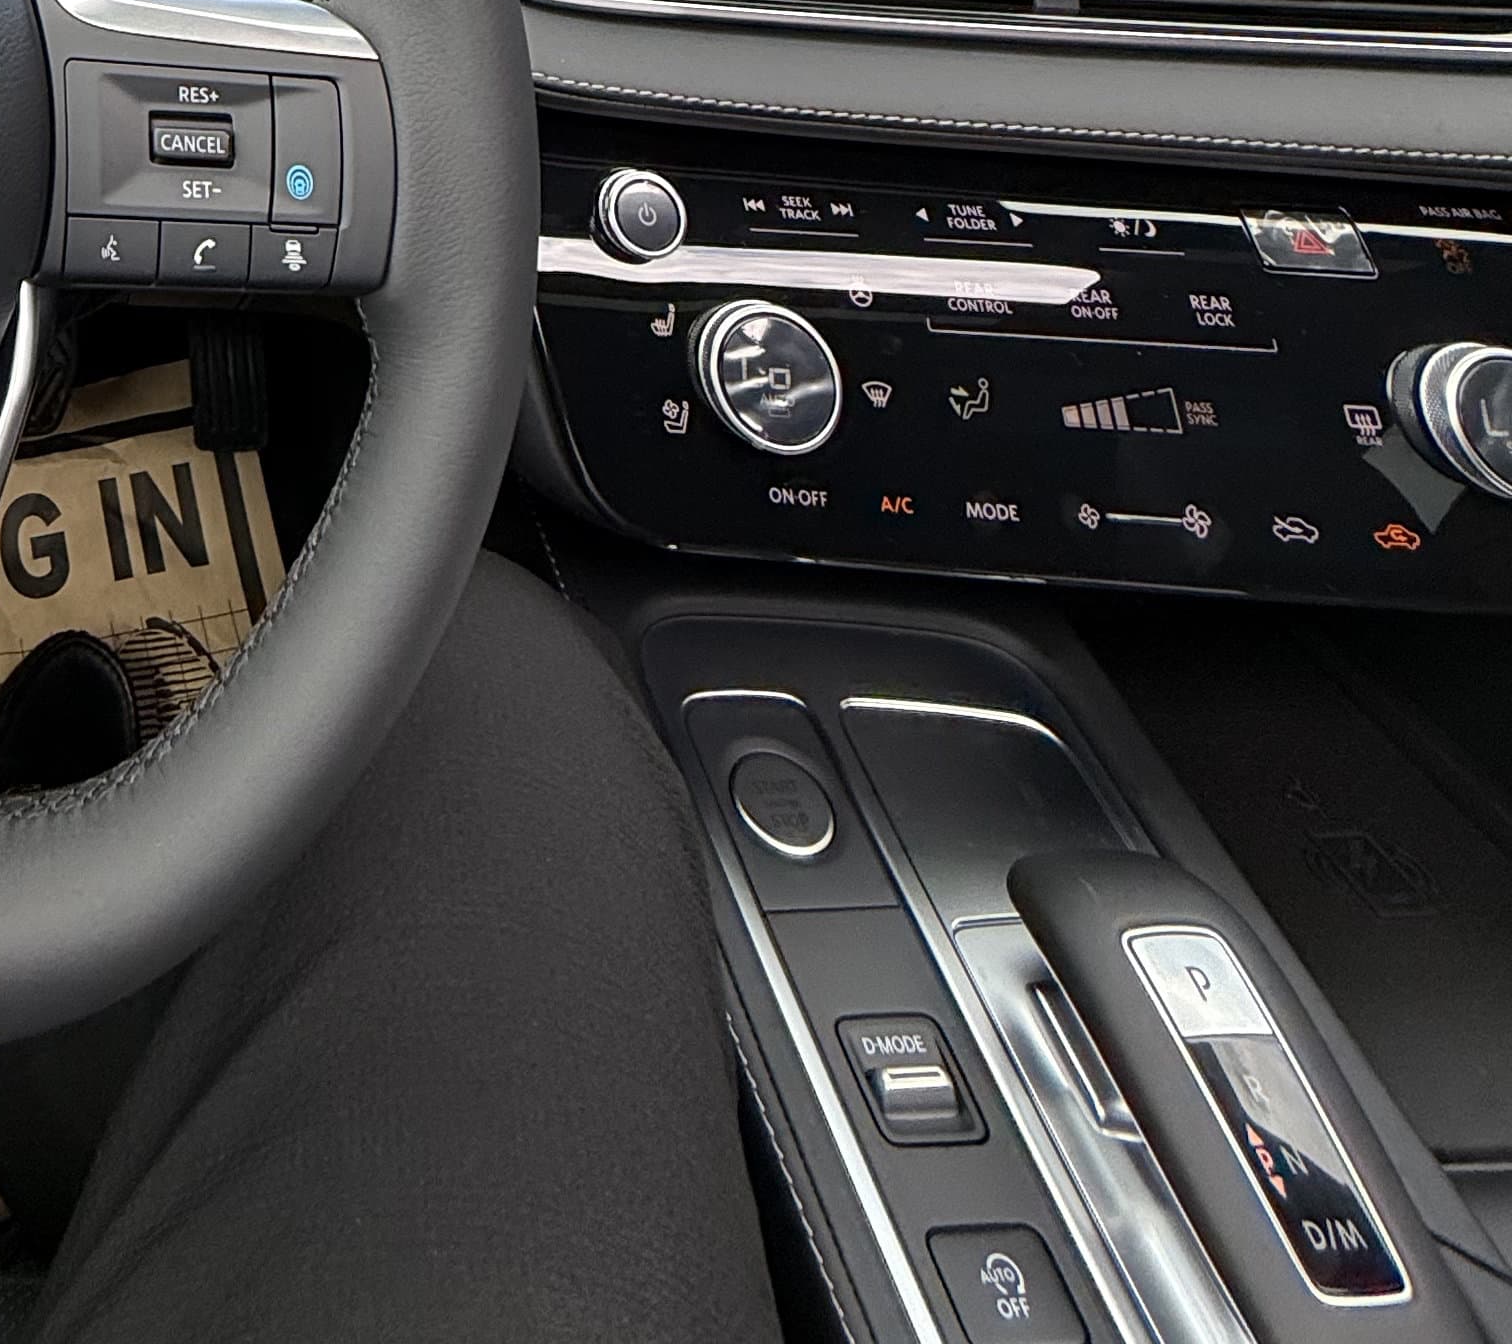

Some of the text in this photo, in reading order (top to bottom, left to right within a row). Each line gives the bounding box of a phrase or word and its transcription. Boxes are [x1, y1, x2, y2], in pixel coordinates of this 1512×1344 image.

[178, 86, 220, 104] RES+
[160, 133, 226, 156] CANCEL
[781, 195, 812, 208] SEEK
[947, 203, 986, 218] TUNE
[779, 207, 821, 221] TRACK
[946, 216, 998, 231] FOLDER
[1071, 288, 1113, 304] REAR
[1189, 294, 1232, 311] REAR
[947, 297, 1014, 314] CONTROL
[1196, 312, 1236, 327] LOCK
[1185, 401, 1214, 414] PASS
[1186, 413, 1219, 427] SYNC
[1356, 435, 1383, 447] REAR
[881, 495, 915, 514] A/C
[965, 500, 1021, 522] MODE
[97, 461, 210, 582] IN
[1184, 965, 1212, 1003] P
[861, 1034, 927, 1055] D-MODE
[1243, 1075, 1271, 1110] R
[1279, 1144, 1310, 1177] N
[1301, 1218, 1369, 1252] D/M
[979, 1267, 1016, 1285] AUTO
[996, 1297, 1031, 1320] OFF
